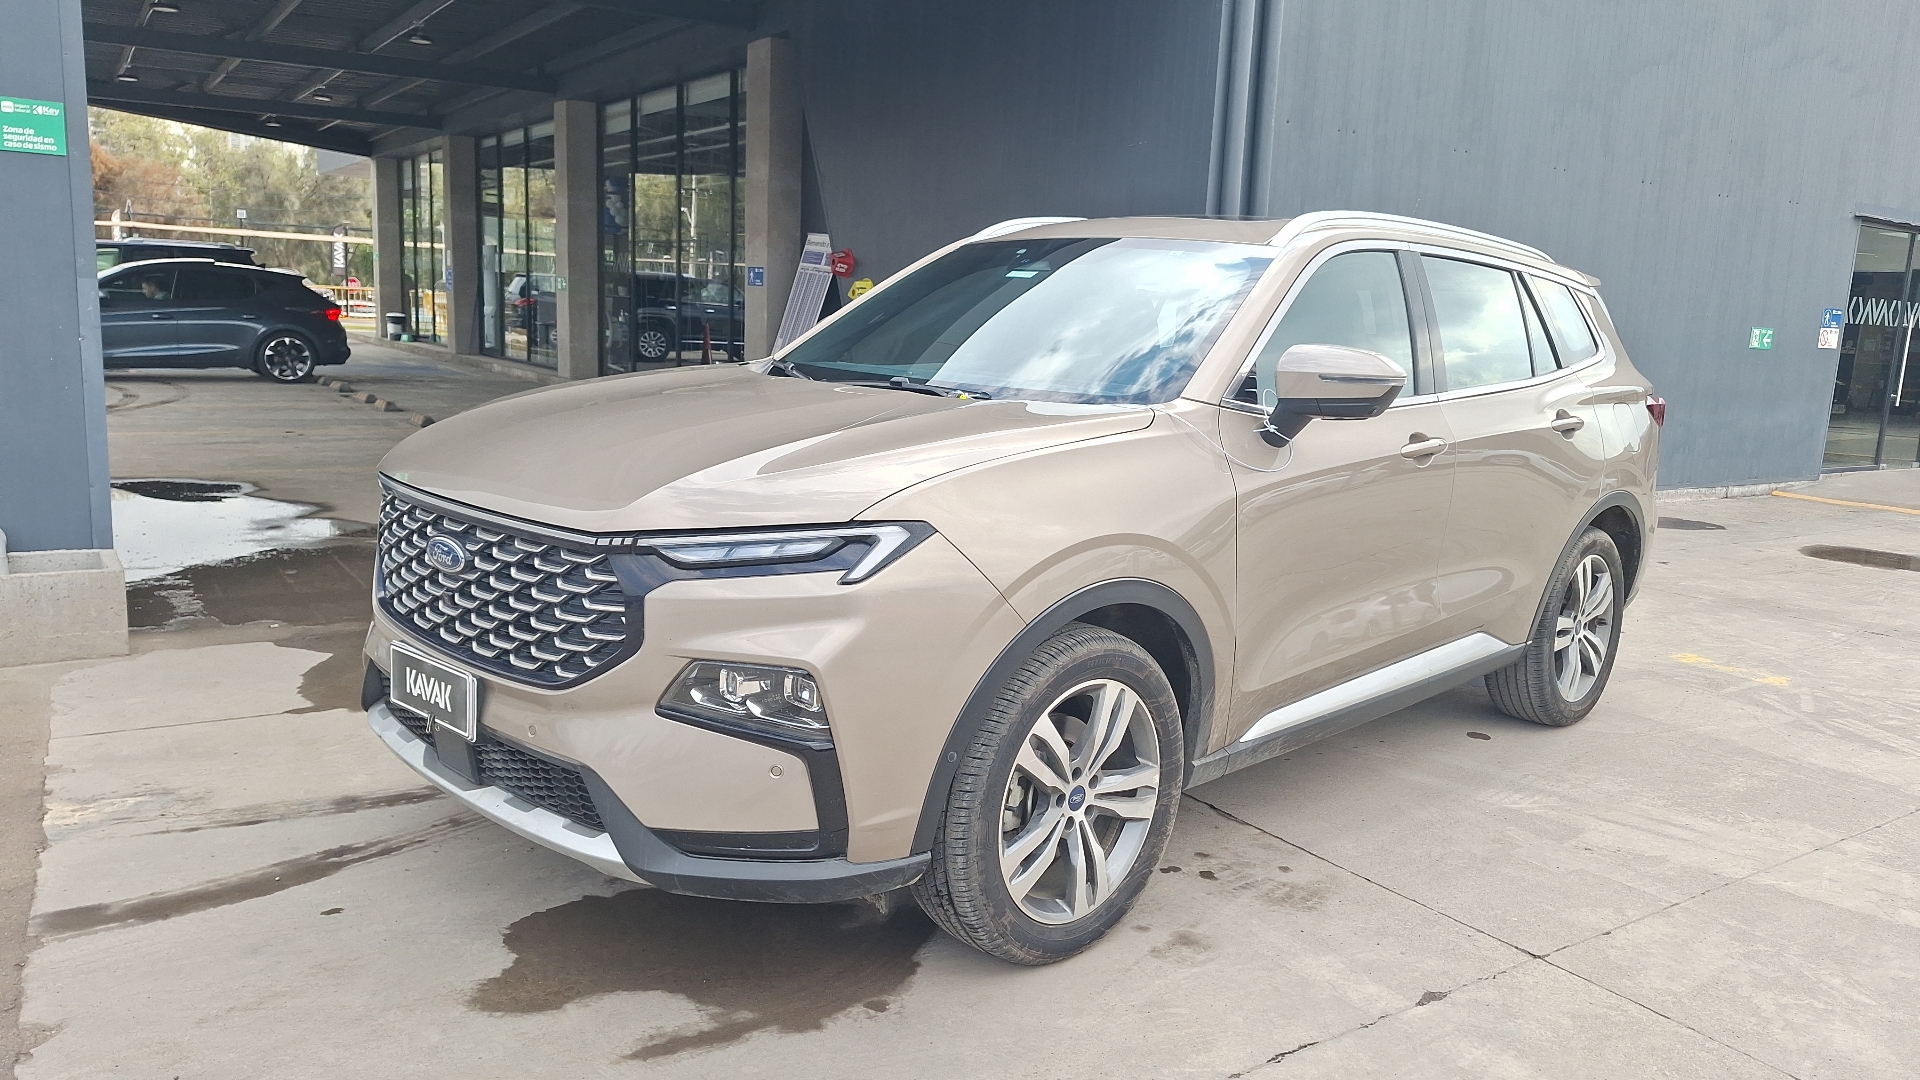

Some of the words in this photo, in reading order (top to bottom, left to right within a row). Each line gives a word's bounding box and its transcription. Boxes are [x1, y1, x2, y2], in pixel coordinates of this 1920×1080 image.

[43, 105, 60, 116] Key
[3, 125, 23, 134] Zona
[24, 127, 35, 135] de
[3, 134, 43, 143] seguridad
[34, 143, 57, 151] sismo
[433, 543, 453, 565] Ford
[406, 666, 452, 712] KAVAK
